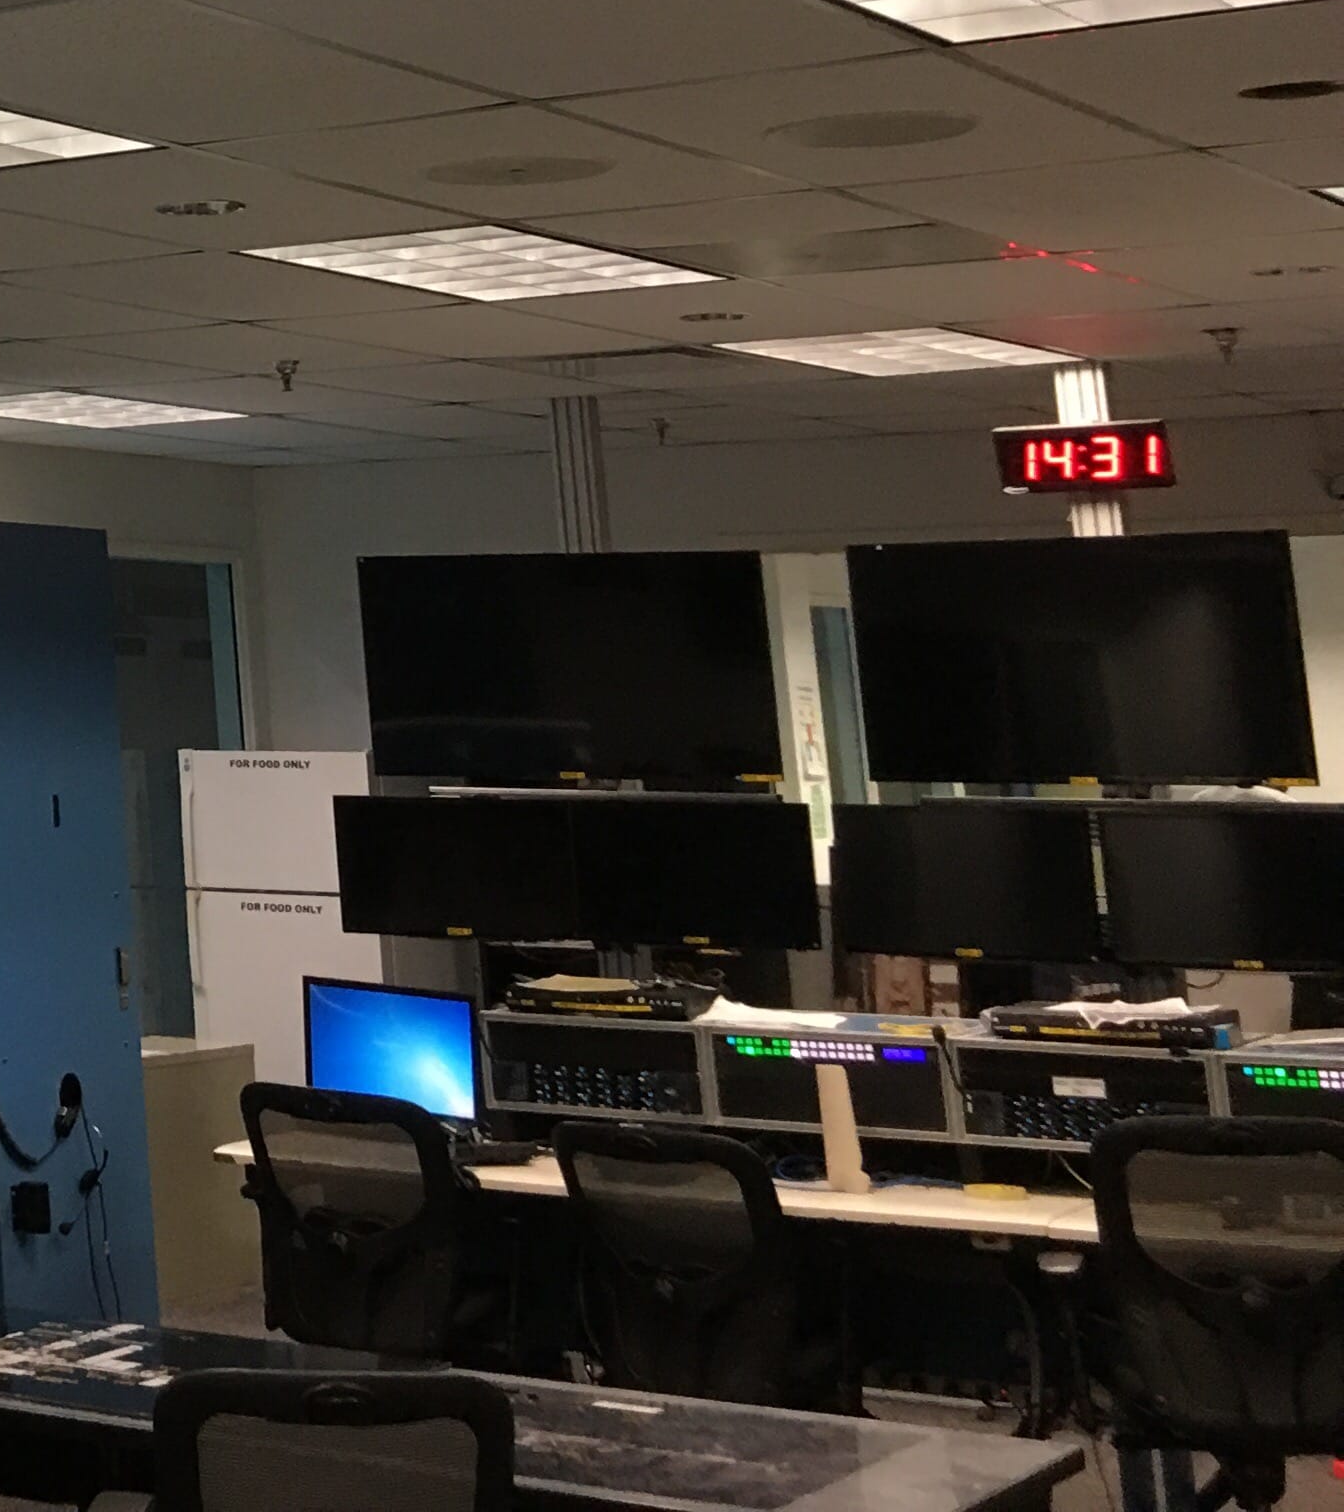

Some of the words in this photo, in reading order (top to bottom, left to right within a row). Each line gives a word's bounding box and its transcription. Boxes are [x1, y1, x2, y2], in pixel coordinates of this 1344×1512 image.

[1024, 434, 1163, 481] 14:31
[229, 759, 250, 769] FOR
[253, 759, 280, 769] FOOD
[283, 760, 311, 770] ONLY
[240, 902, 261, 912] FOR
[264, 903, 292, 913] FOOD
[295, 904, 323, 915] ONLY
